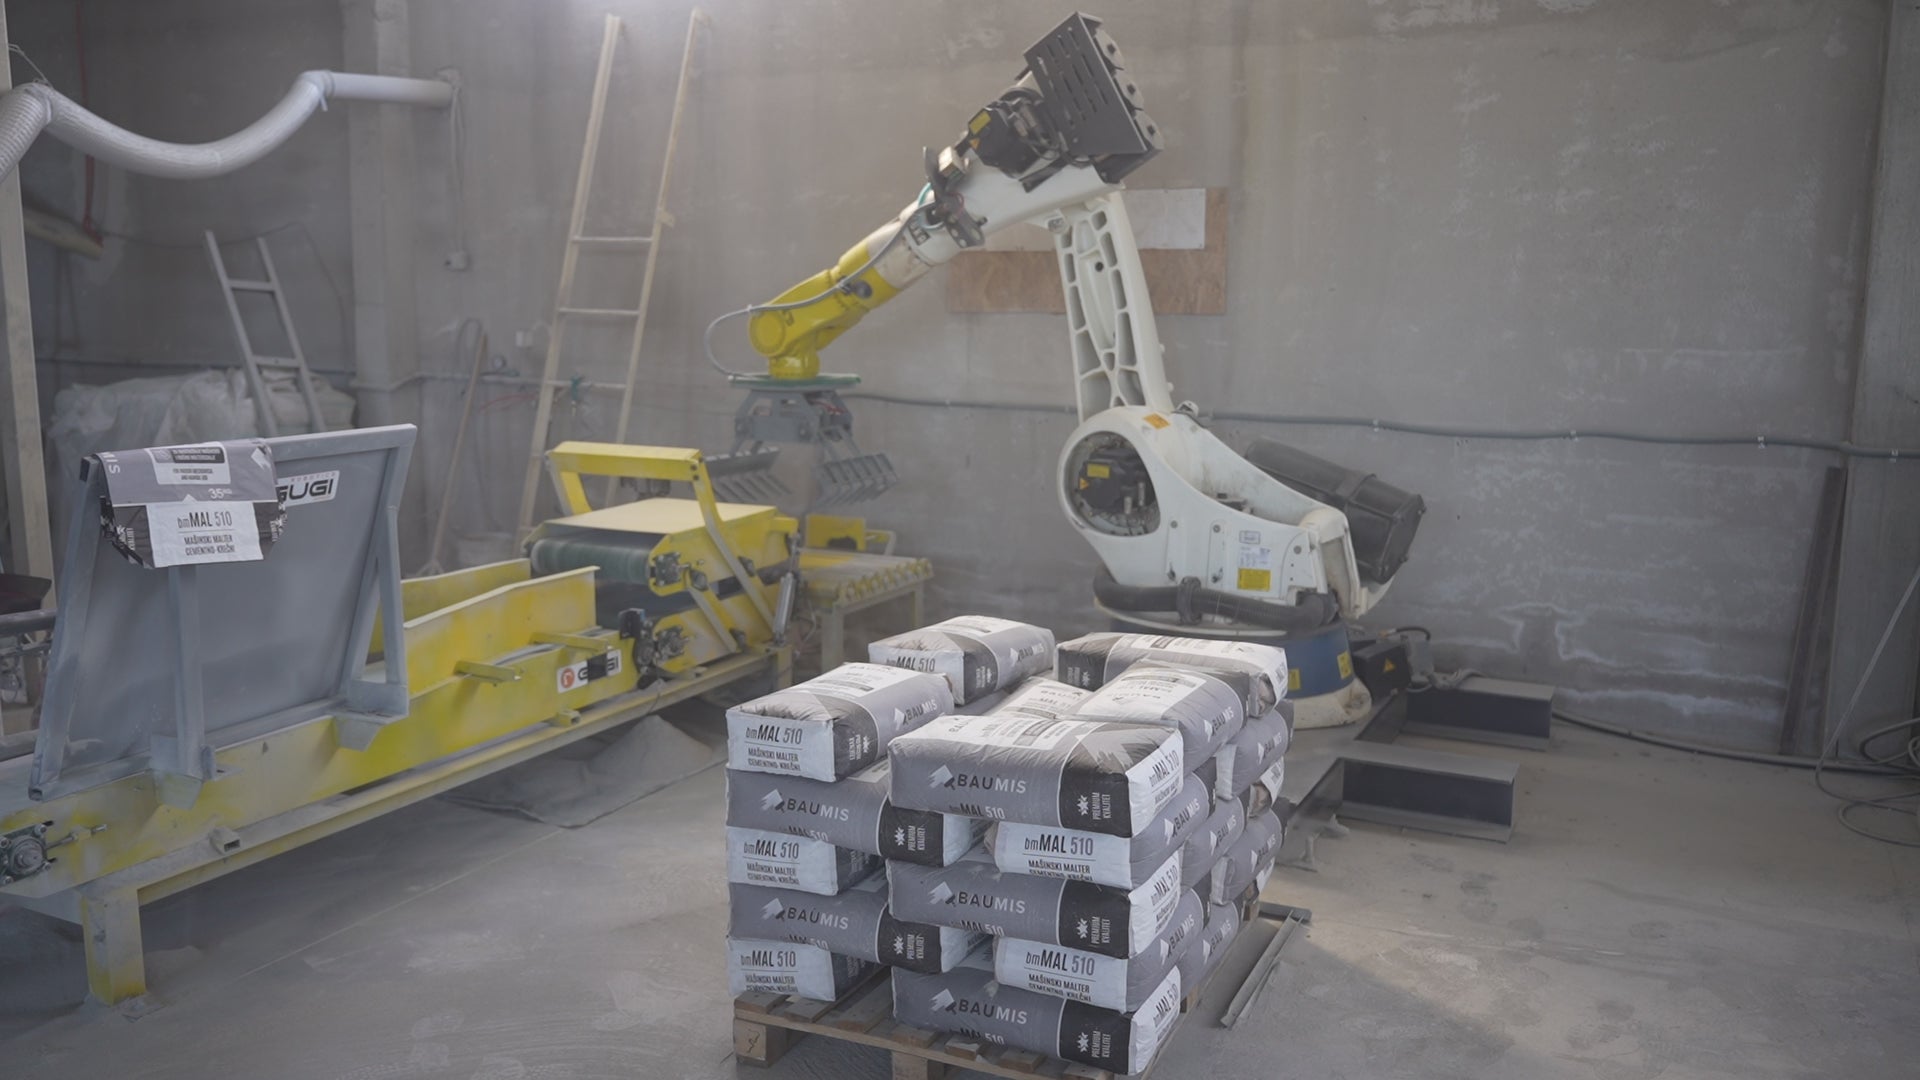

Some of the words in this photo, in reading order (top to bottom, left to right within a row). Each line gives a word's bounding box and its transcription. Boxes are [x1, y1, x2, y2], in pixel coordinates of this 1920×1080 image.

[214, 511, 233, 527] 510
[918, 658, 936, 673] 510
[906, 699, 938, 721] BAUMIS
[782, 727, 803, 745] 510
[957, 773, 1027, 794] BAUMIS
[787, 798, 849, 821] BAUMIS
[984, 805, 1006, 819] 510
[1092, 792, 1100, 821] PREMIUM
[1174, 797, 1201, 831] BAUMIS
[780, 842, 800, 860] 510
[1024, 833, 1067, 854] bmMAL
[1070, 836, 1095, 856] 510
[1063, 863, 1091, 874] MALTER
[958, 891, 1026, 914] BAUMIS
[787, 906, 849, 930] BAUMIS
[1091, 917, 1100, 944] PREMIUM
[777, 951, 797, 967] 510
[1025, 949, 1068, 972] bmMAL
[1071, 955, 1096, 976] 510
[1063, 980, 1090, 993] MALTER
[958, 999, 1028, 1025] BAUMIS
[1092, 1031, 1100, 1058] PREMIUM
